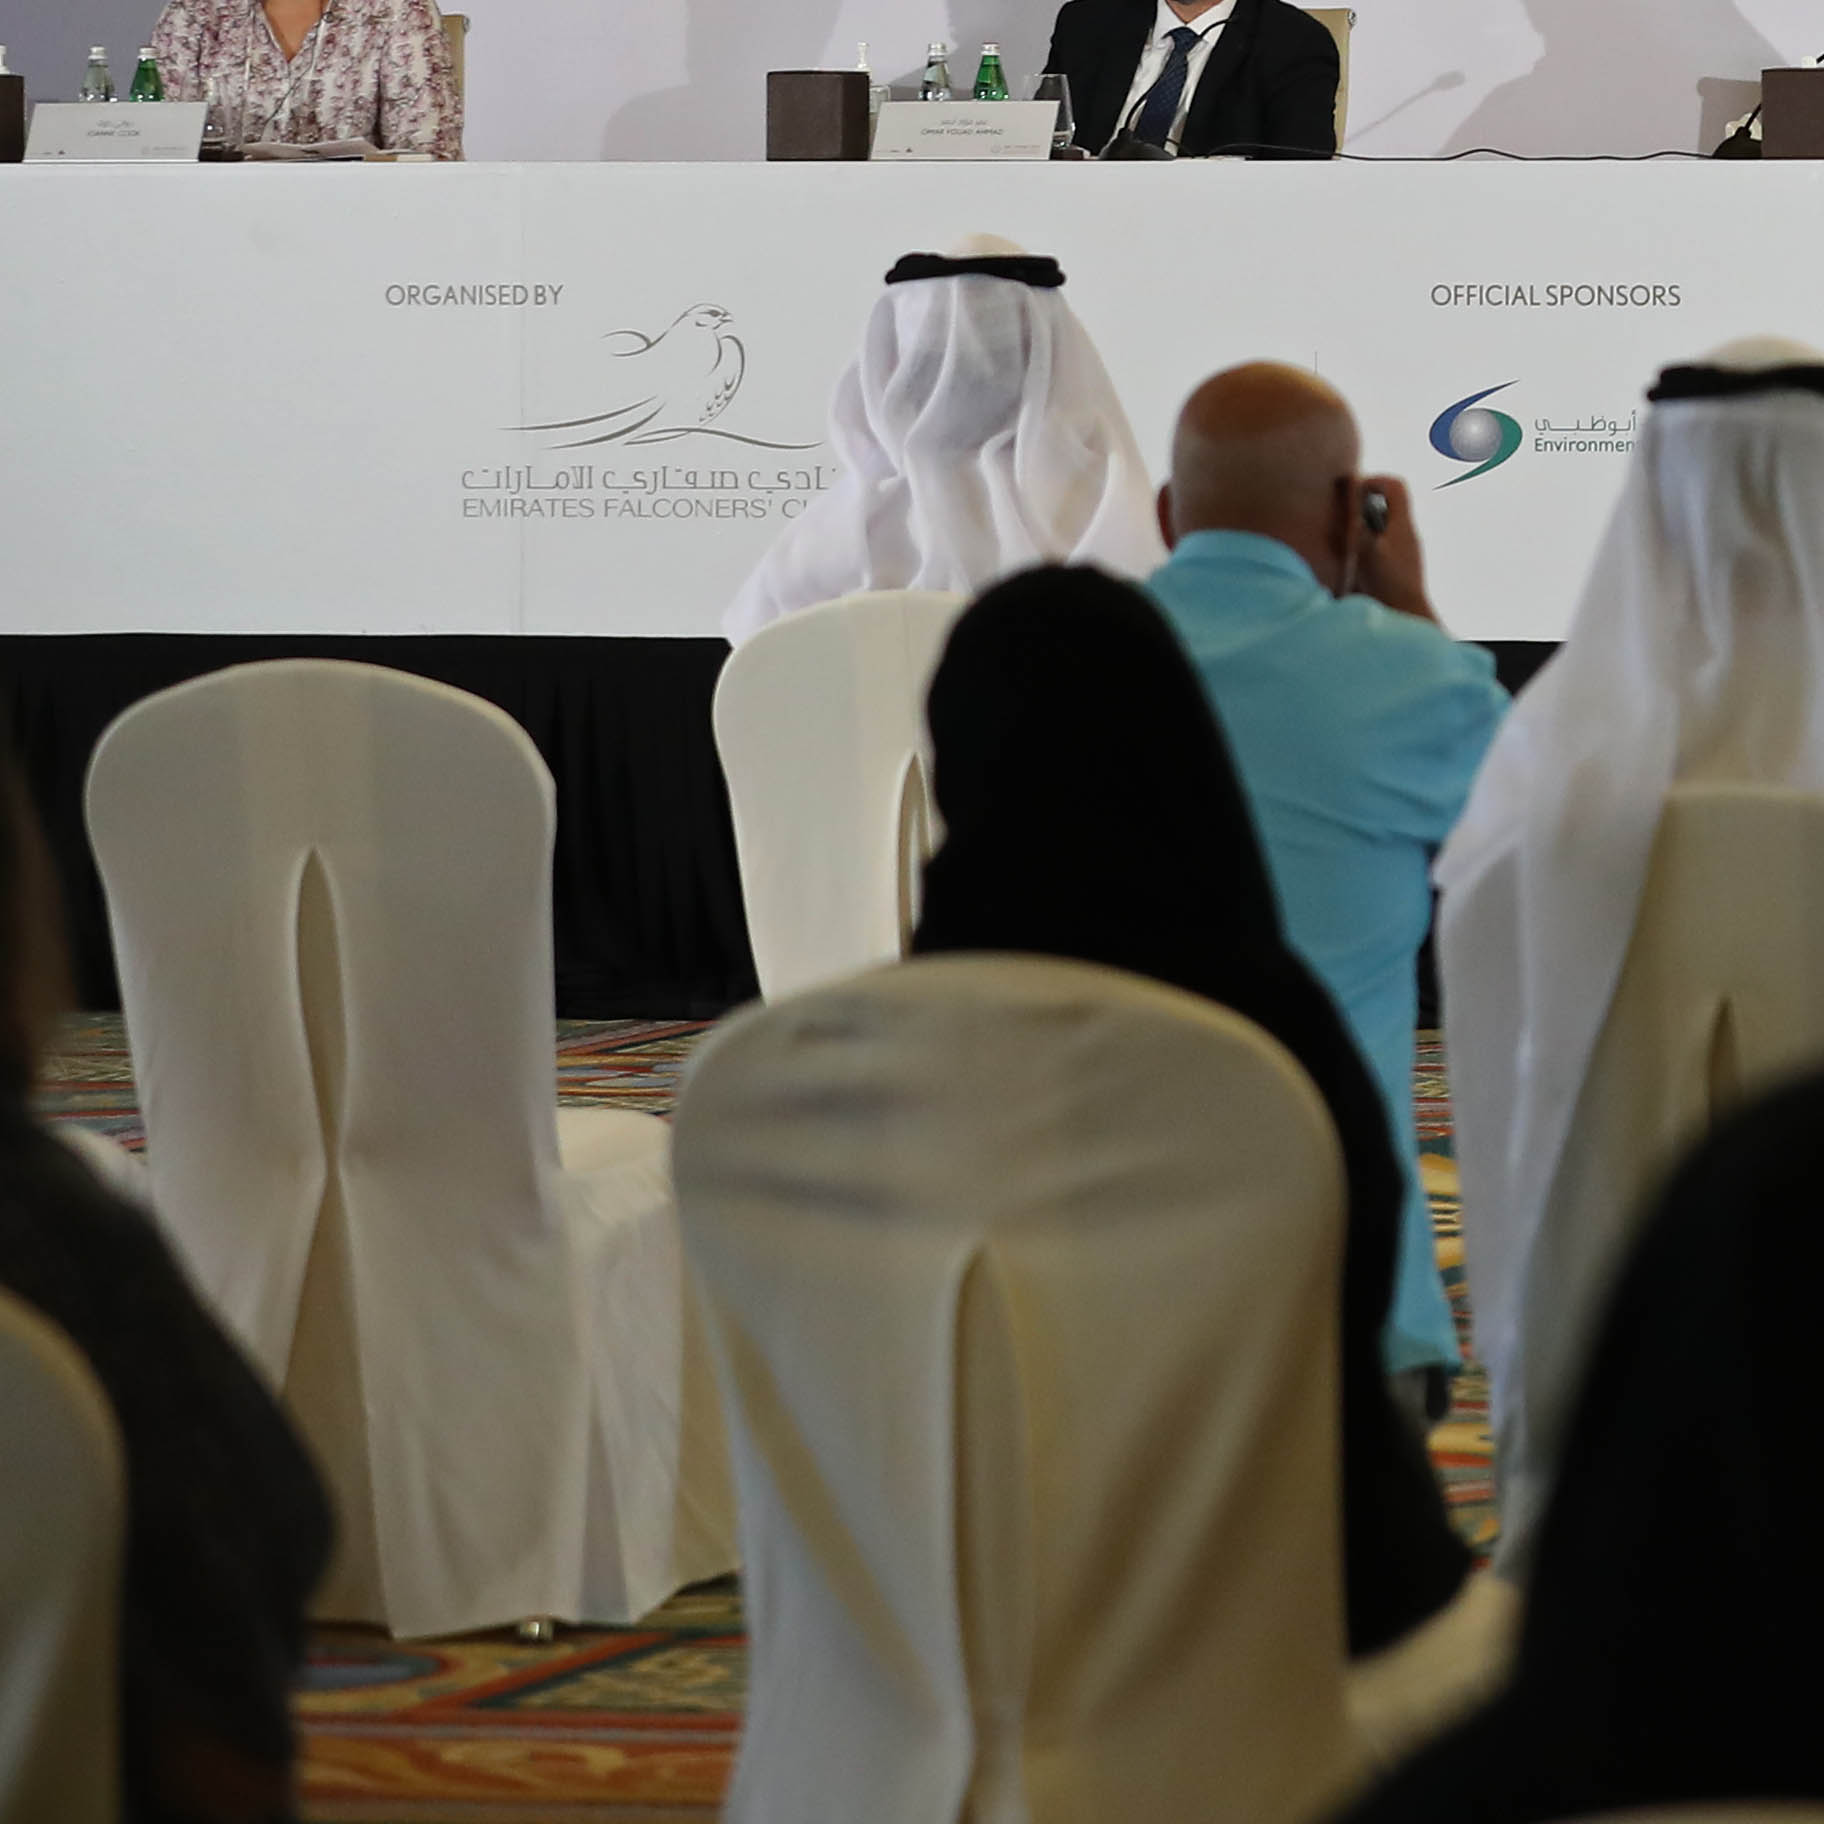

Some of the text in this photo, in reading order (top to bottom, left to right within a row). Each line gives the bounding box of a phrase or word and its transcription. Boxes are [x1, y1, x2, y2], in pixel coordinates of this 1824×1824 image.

[385, 284, 564, 306] ORGANISED BY
[1430, 284, 1681, 307] OFFICIAL SPONSORS
[1533, 409, 1637, 437] أبوظبي
[1533, 435, 1635, 454] Environmen
[602, 465, 740, 496] صقاري
[462, 498, 595, 518] EMIRATES
[603, 498, 773, 519] FALCONERS'
